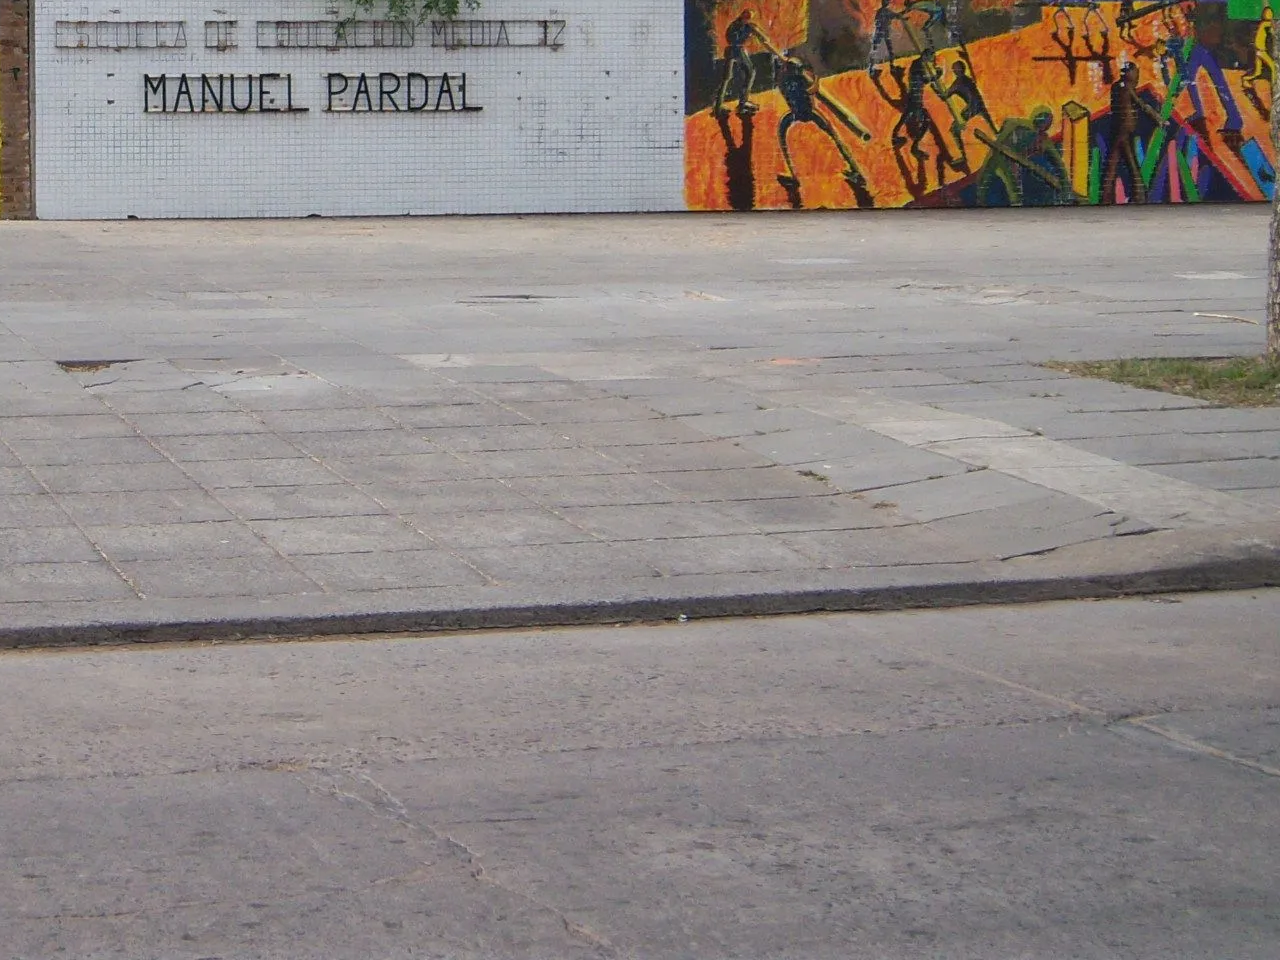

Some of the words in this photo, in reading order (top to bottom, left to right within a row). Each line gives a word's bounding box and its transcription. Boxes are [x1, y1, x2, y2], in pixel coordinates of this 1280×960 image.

[55, 19, 188, 49] ESCUELA
[204, 19, 239, 49] DE
[431, 19, 511, 48] MEDIA
[143, 73, 310, 113] MANUEL
[323, 72, 484, 113] PARDAL
